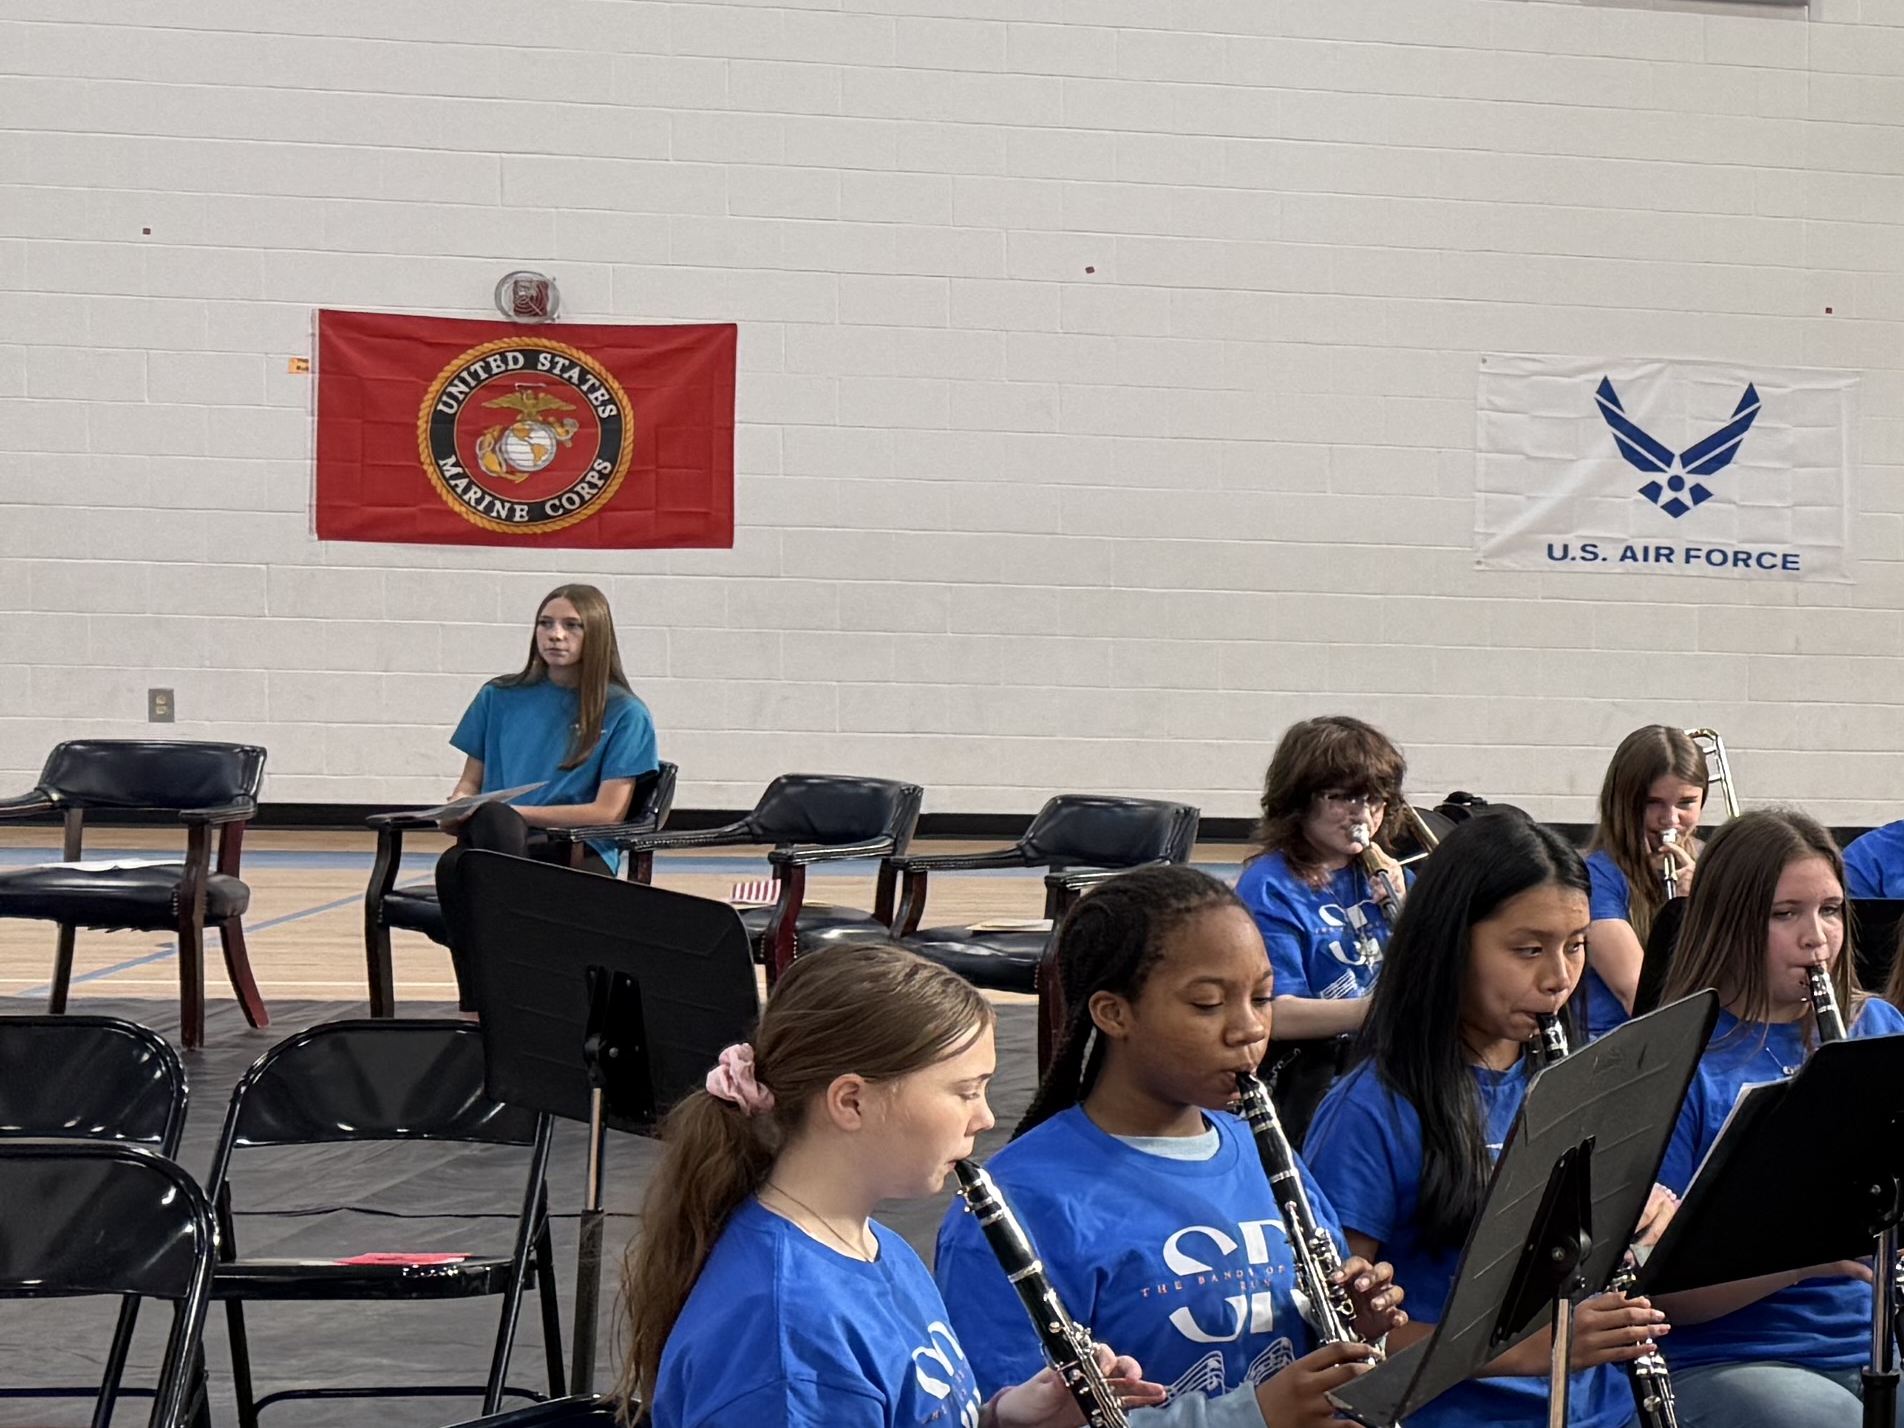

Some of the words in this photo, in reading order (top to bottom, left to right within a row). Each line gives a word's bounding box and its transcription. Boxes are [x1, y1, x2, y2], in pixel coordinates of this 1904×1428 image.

[437, 352, 525, 416] UNITED
[537, 353, 617, 420] STATES
[438, 455, 530, 523] MARINE
[544, 458, 613, 518] CORPS
[1546, 543, 1607, 562] U.S.
[1619, 545, 1675, 564] AIR
[1684, 547, 1801, 571] FORCE
[1140, 1280, 1184, 1297] THE
[1197, 1268, 1257, 1285] BANDS
